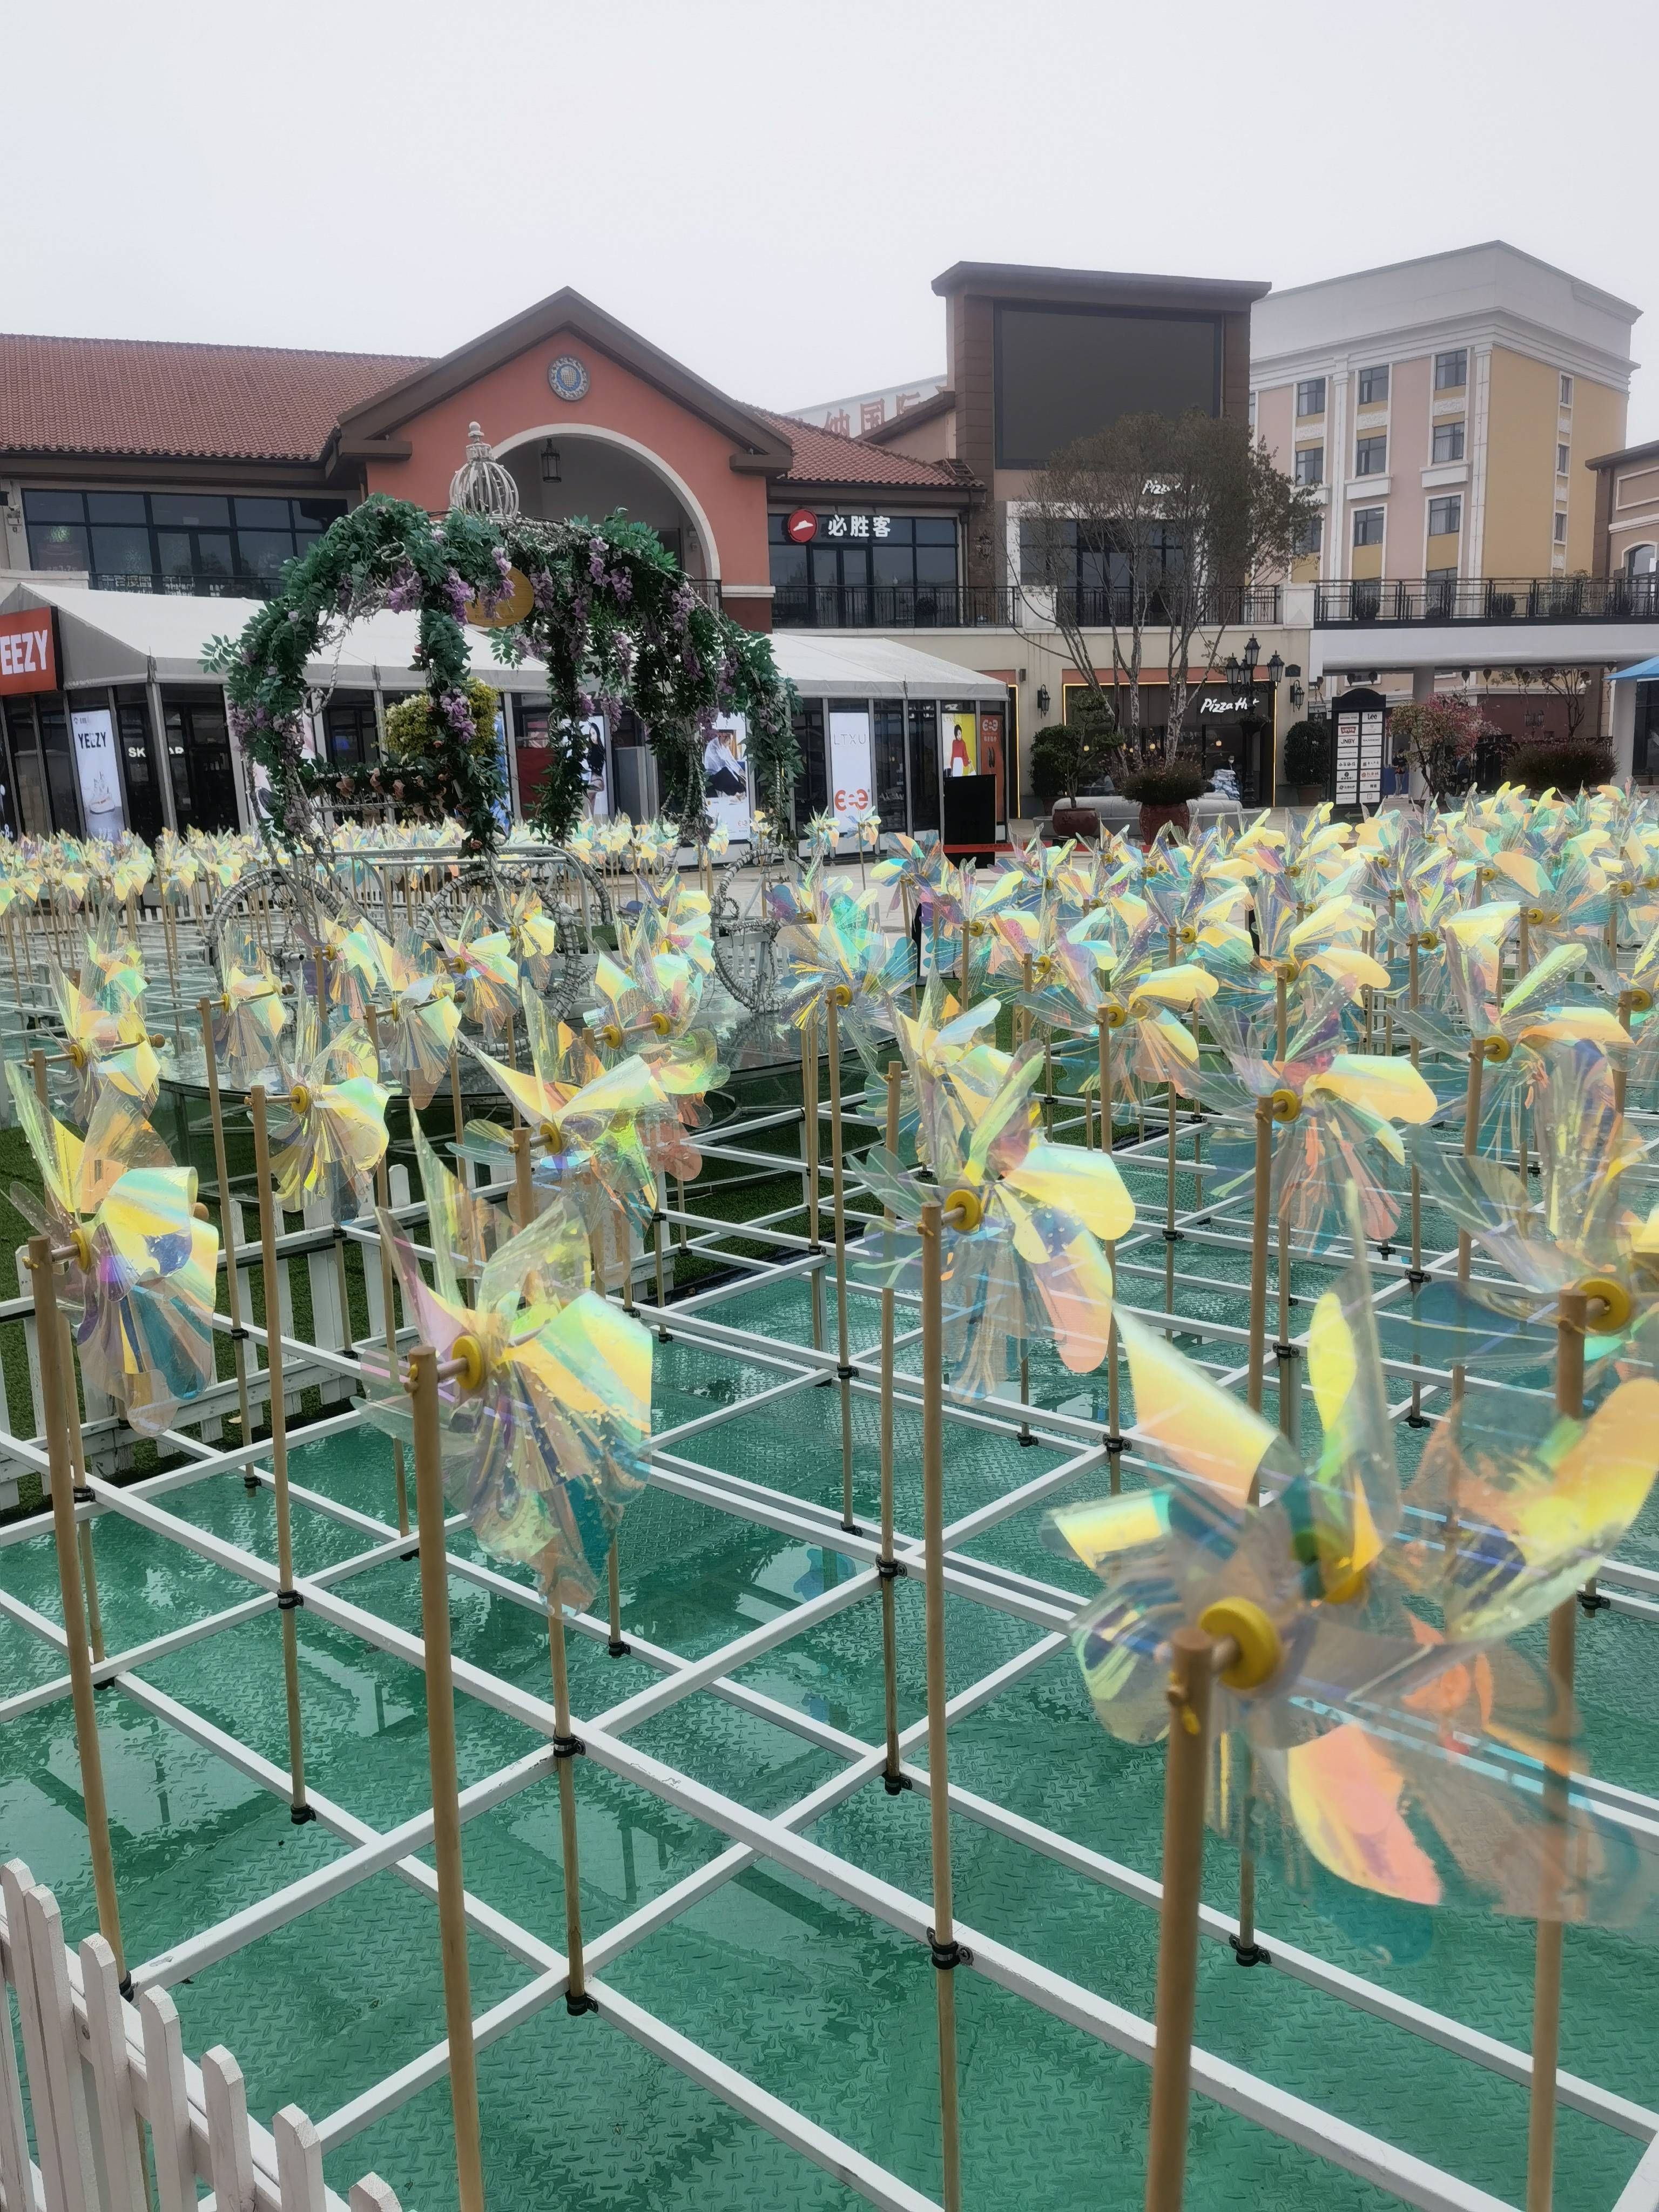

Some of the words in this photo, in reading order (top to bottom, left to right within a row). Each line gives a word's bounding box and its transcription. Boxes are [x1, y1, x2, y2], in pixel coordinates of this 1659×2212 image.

[828, 514, 891, 537] 必胜客
[0, 629, 48, 675] EEZY
[1201, 698, 1233, 713] Pizza
[1235, 697, 1259, 711] Ht
[834, 733, 866, 745] LTXU
